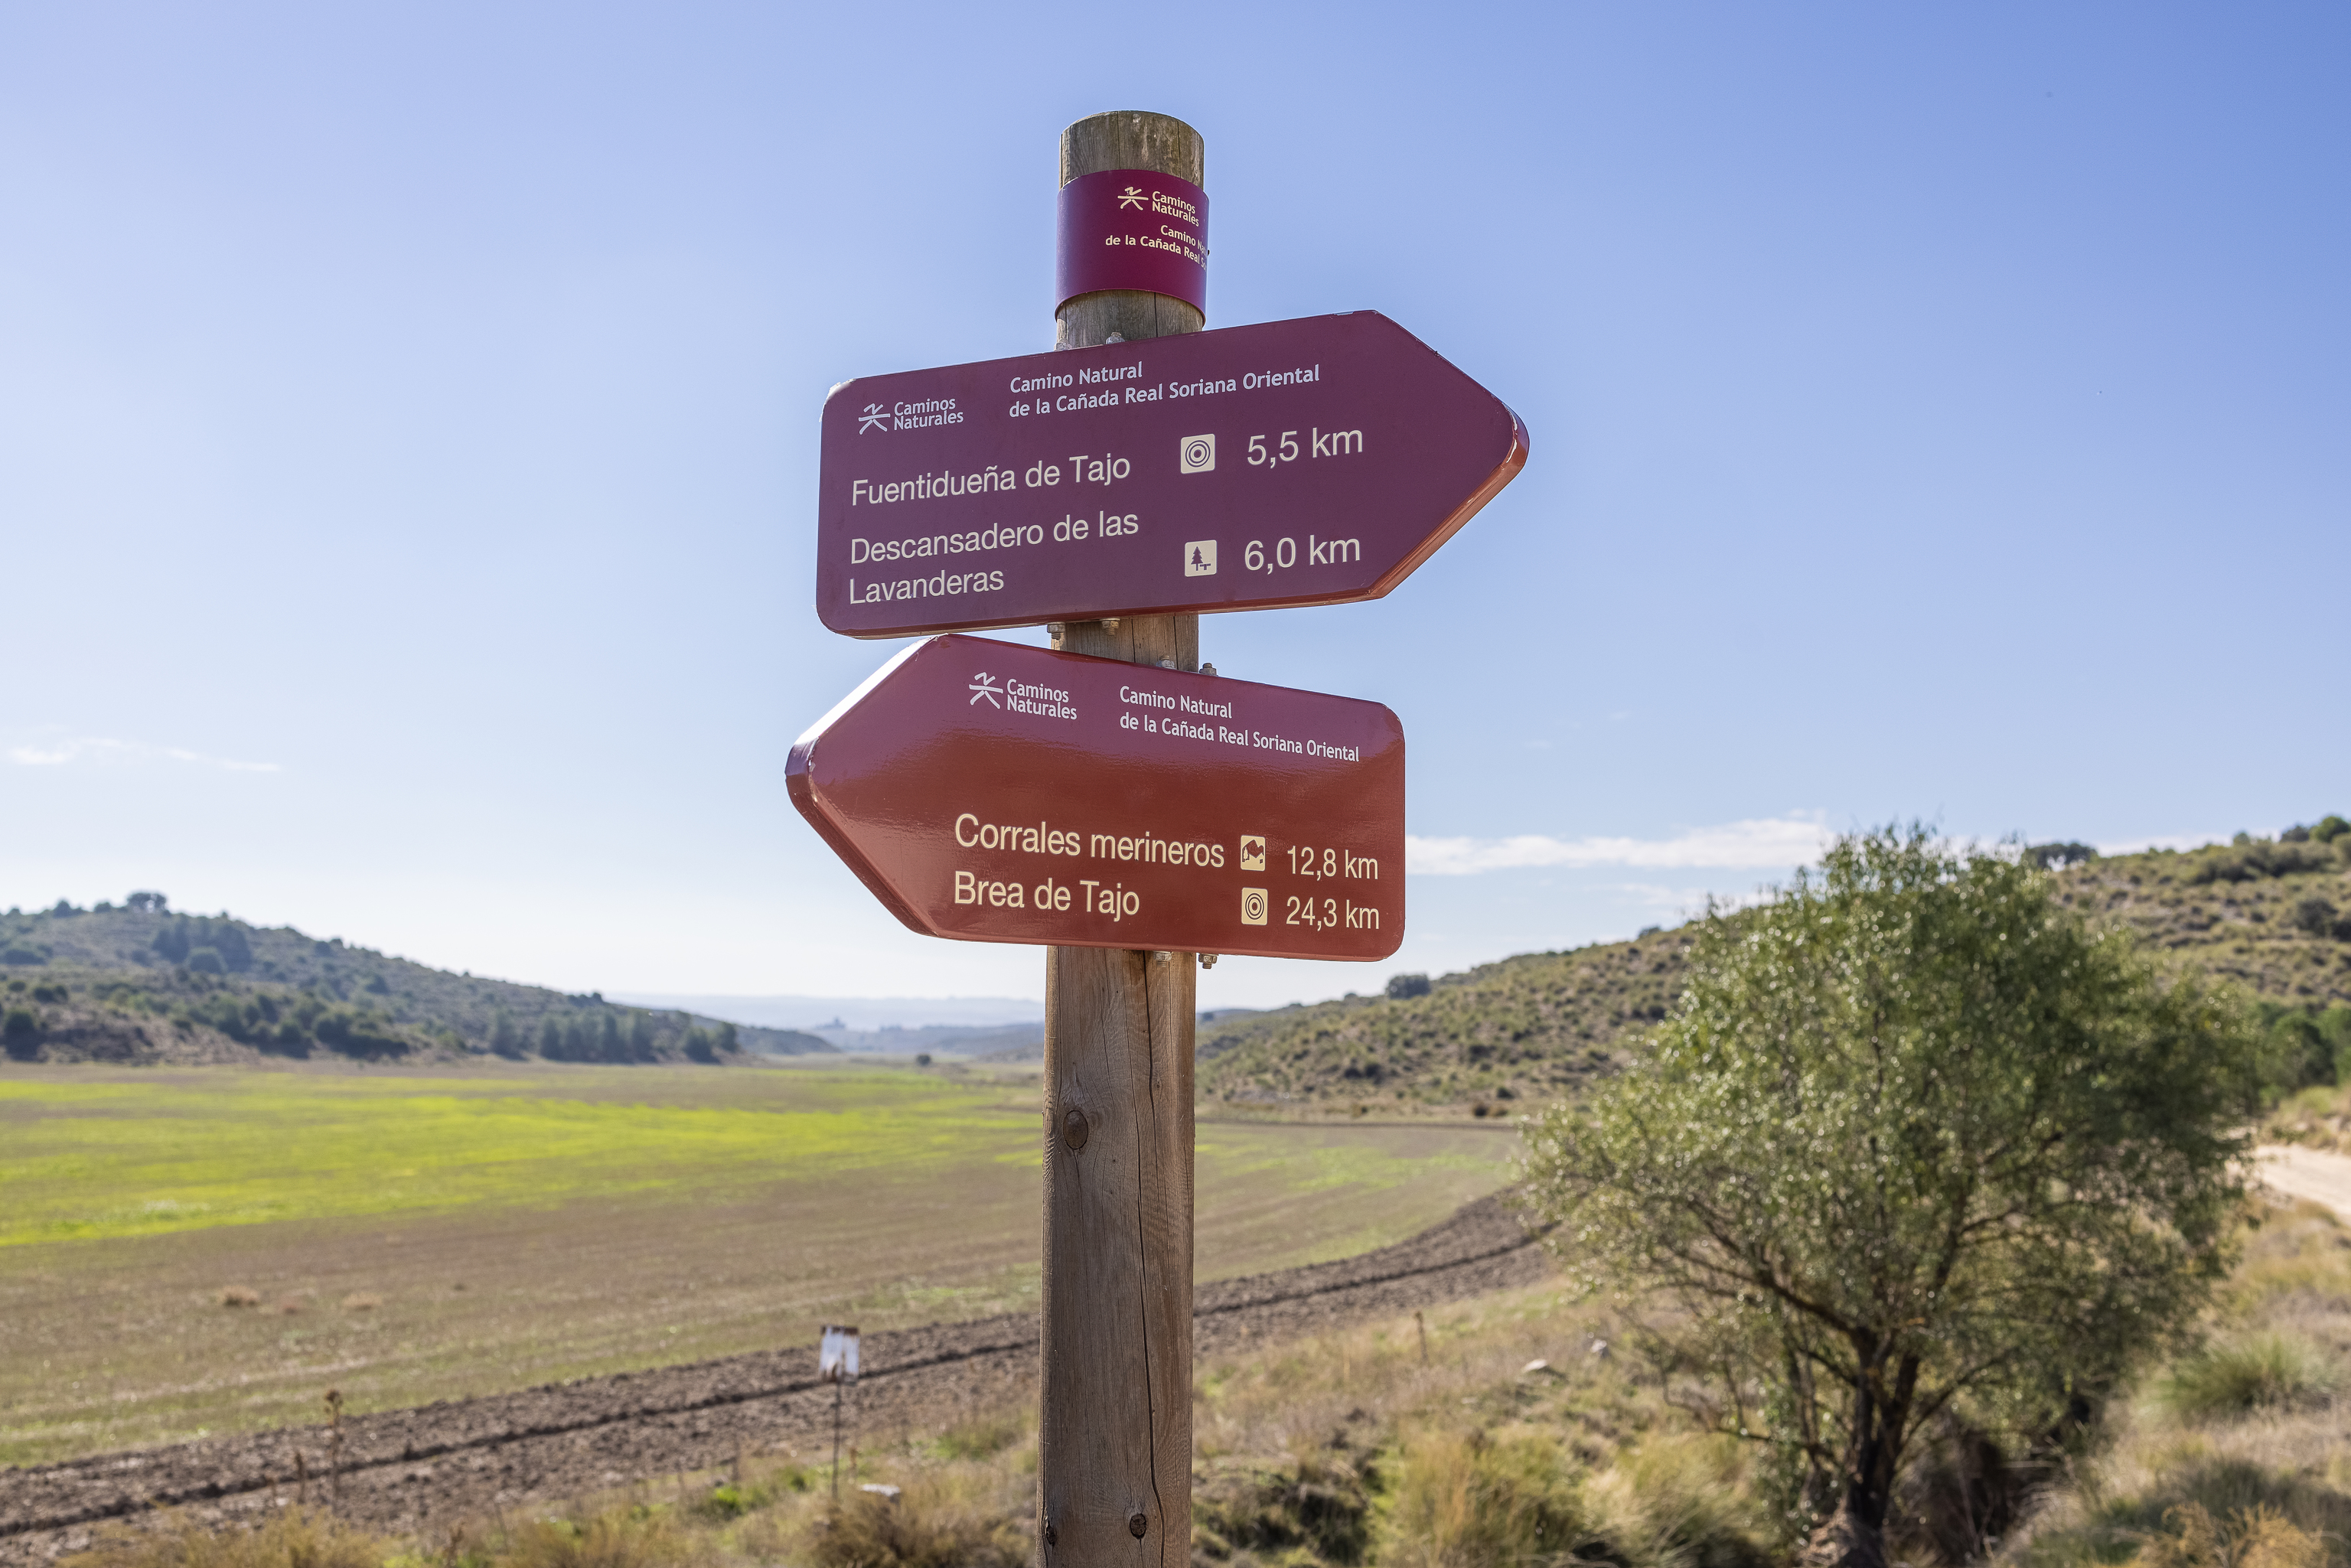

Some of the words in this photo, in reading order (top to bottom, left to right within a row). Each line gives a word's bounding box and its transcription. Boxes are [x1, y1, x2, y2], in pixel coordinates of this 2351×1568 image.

[1152, 191, 1195, 214] Caminos
[1152, 201, 1199, 227] Naturales
[1105, 235, 1121, 246] de
[1125, 234, 1136, 246] la
[1140, 236, 1182, 255] Cañada
[1184, 246, 1200, 265] Real
[1160, 225, 1195, 246] Camino
[1009, 373, 1073, 394] Camino
[1078, 361, 1143, 385] Natural
[1009, 400, 1030, 418] de
[1036, 397, 1051, 415] la
[1055, 389, 1119, 412] Cañada
[1125, 383, 1163, 405] Real
[1169, 377, 1237, 399] Soriana
[1243, 363, 1320, 390] Oriental
[893, 398, 956, 417] Caminos
[893, 409, 964, 431] Naturales
[852, 465, 1016, 506] Fuentidueña
[1025, 460, 1061, 488] de
[1069, 452, 1130, 486] Tajo
[1247, 430, 1299, 469] 5,5
[1312, 427, 1363, 458] km
[851, 522, 1044, 565] Descansadero
[1053, 513, 1089, 543] de
[1099, 510, 1139, 537] las
[1244, 536, 1296, 575] 6,0
[1309, 534, 1361, 566] km
[849, 569, 1005, 605] Lavanderas
[1006, 678, 1070, 703] Caminos
[1120, 686, 1176, 710] Camino
[1180, 694, 1233, 719] Natural
[1006, 695, 1078, 720] Naturales
[1120, 711, 1139, 730] de
[1144, 714, 1157, 733] la
[1162, 717, 1215, 742] Cañada
[1218, 725, 1249, 747] Real
[1253, 731, 1303, 755] Soriana
[1306, 739, 1360, 763] Oriental
[955, 813, 1081, 856] Corrales
[1090, 831, 1225, 868] merineros
[1286, 845, 1338, 882] 12,8
[1345, 849, 1379, 880] km
[954, 870, 1026, 908] Brea
[1034, 877, 1071, 911] de
[1079, 879, 1140, 922] Tajo
[1286, 895, 1338, 932] 24,3
[1345, 898, 1380, 930] km
